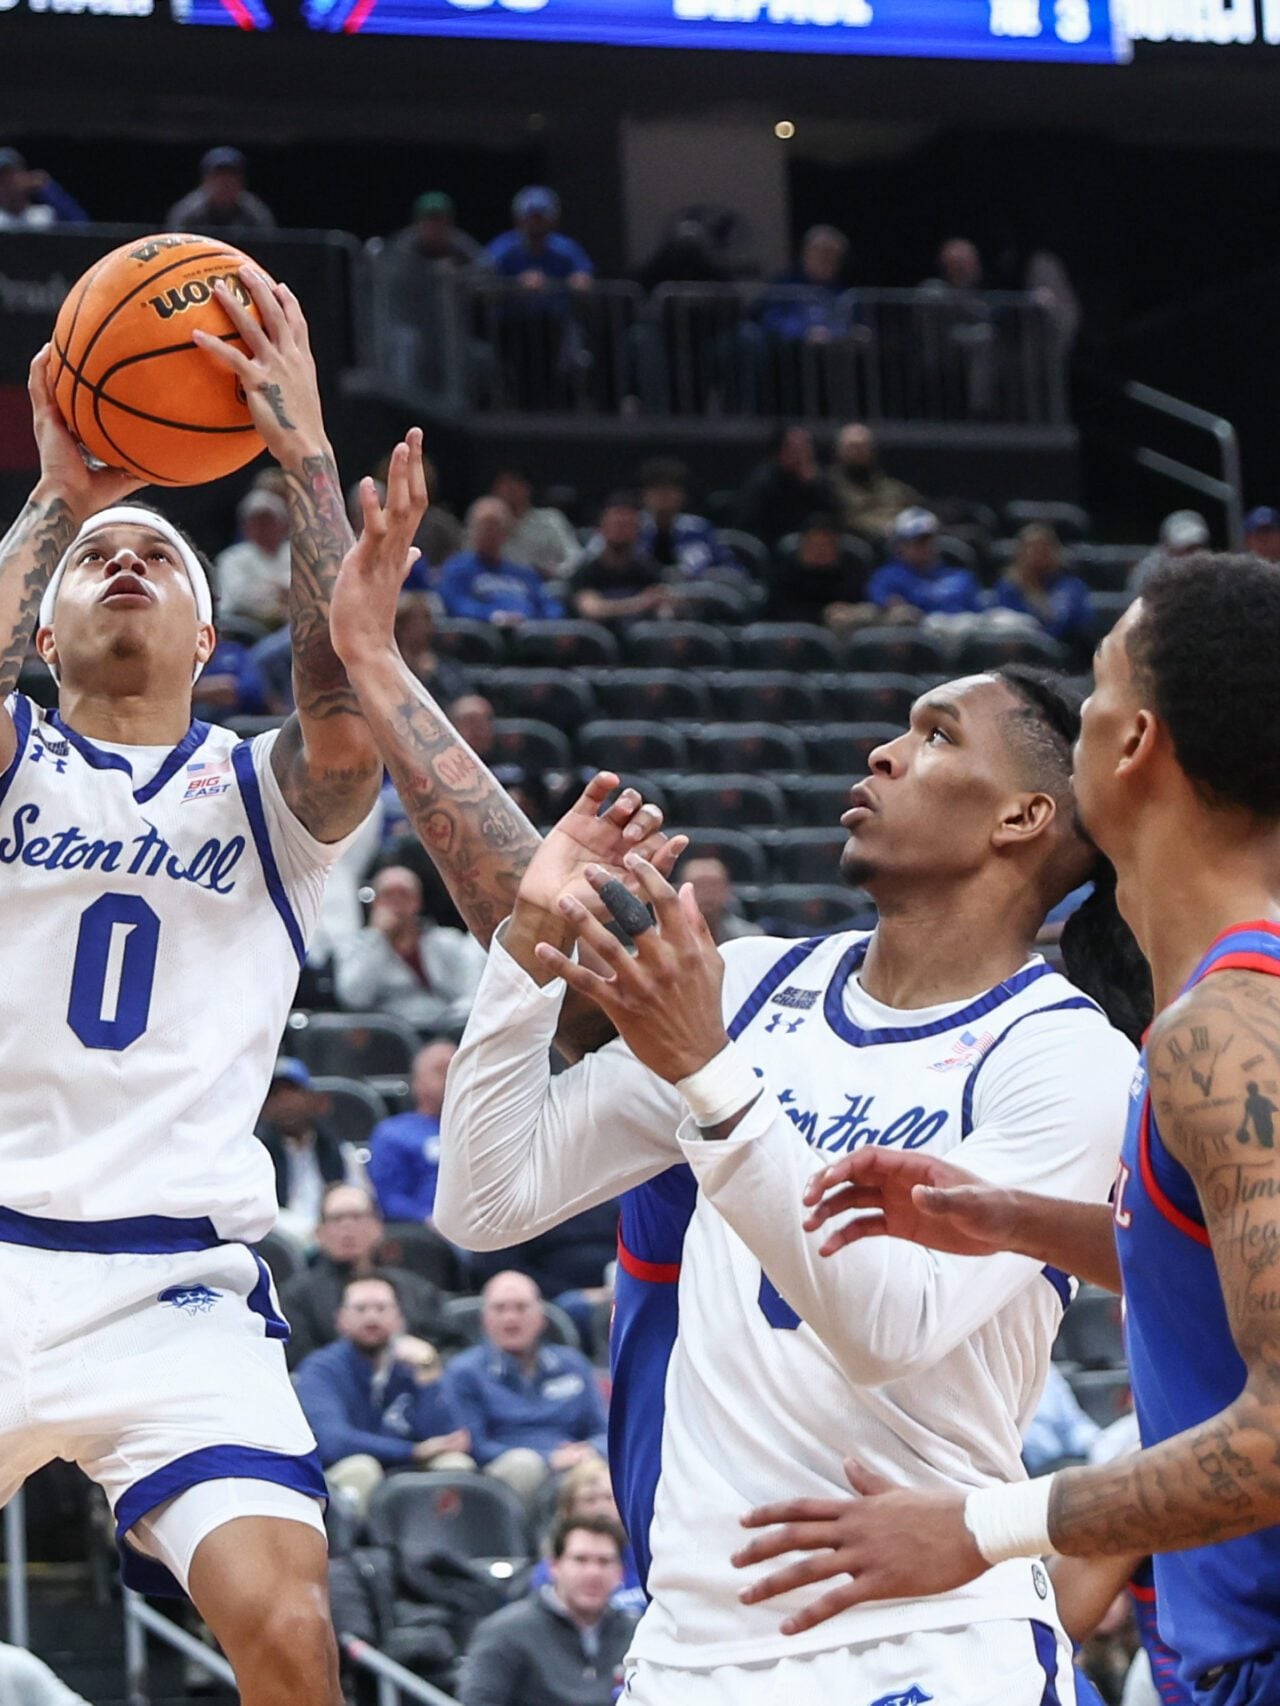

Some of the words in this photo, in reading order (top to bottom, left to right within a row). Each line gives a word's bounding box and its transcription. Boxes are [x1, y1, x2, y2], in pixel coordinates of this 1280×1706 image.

[183, 783, 231, 799] EAST
[187, 776, 221, 790] BIG
[126, 816, 246, 894] Hall
[67, 892, 161, 1052] 0
